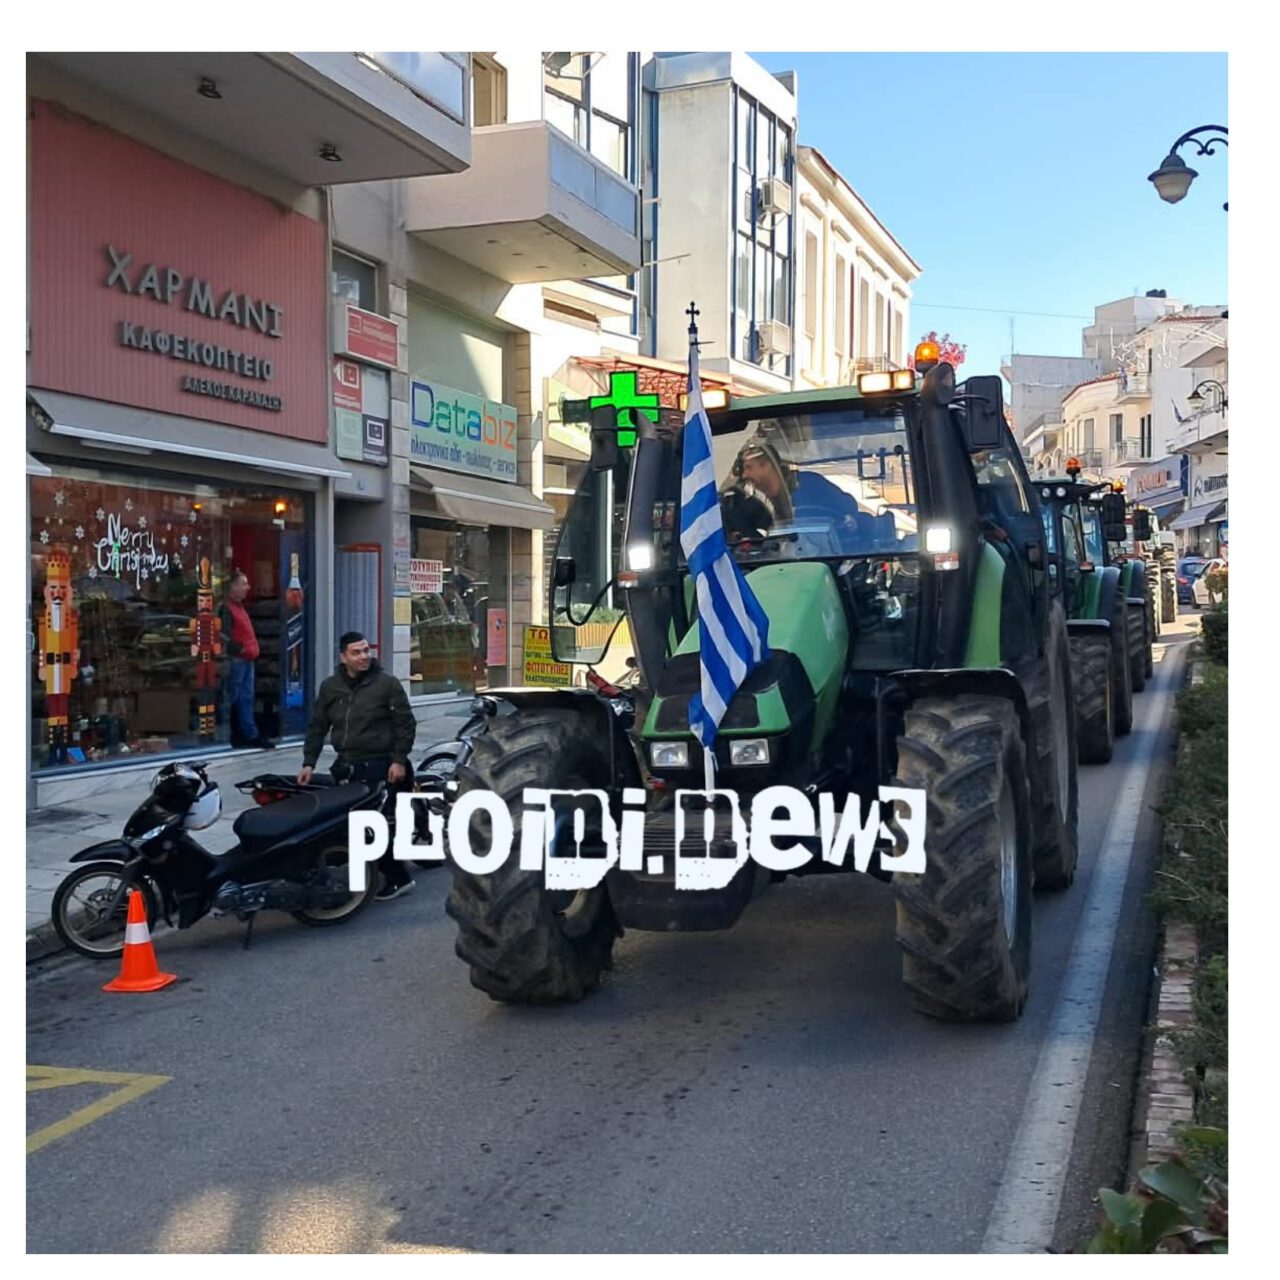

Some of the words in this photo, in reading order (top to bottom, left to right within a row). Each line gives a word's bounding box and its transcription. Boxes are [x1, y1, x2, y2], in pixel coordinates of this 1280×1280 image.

[106, 244, 284, 338] ΧΑΡΜΑΝΙ
[121, 320, 274, 381] ΚΑΦΕΚΟΠΤΕΙΟ
[411, 381, 517, 450] Databiz
[92, 537, 169, 590] Christmas
[107, 512, 156, 566] Merry
[528, 628, 549, 641] ΤΩ
